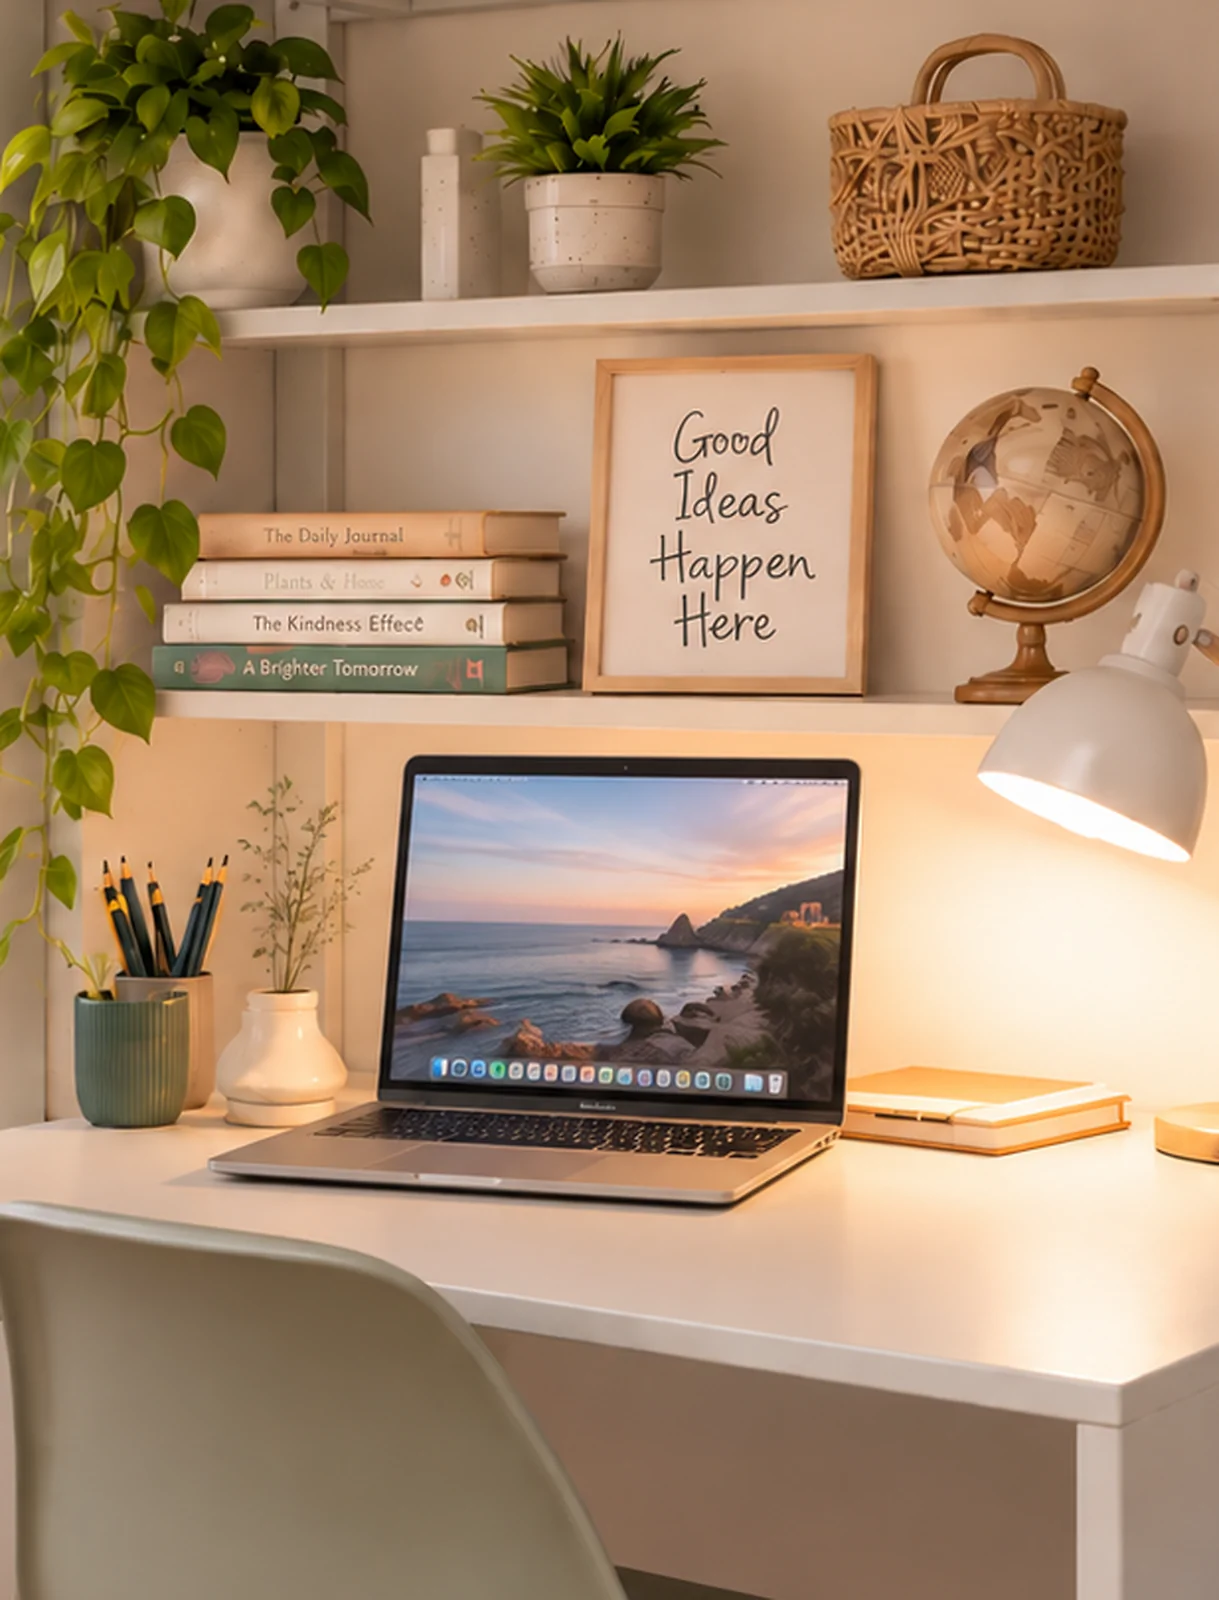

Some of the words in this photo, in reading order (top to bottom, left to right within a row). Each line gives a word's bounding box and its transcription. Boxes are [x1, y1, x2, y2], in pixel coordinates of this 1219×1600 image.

[673, 406, 780, 466] Good
[673, 469, 789, 524] Ideas
[264, 528, 293, 543] The
[299, 527, 338, 547] Daily
[345, 527, 404, 544] Journal
[264, 573, 313, 590] Plants
[320, 573, 335, 590] &
[649, 530, 816, 602] Happen
[253, 615, 282, 632] The
[287, 615, 362, 632] Kindness
[673, 591, 776, 648] Here
[243, 660, 256, 675] A
[260, 658, 327, 681] Brighter
[333, 659, 418, 677] Tomorrow
